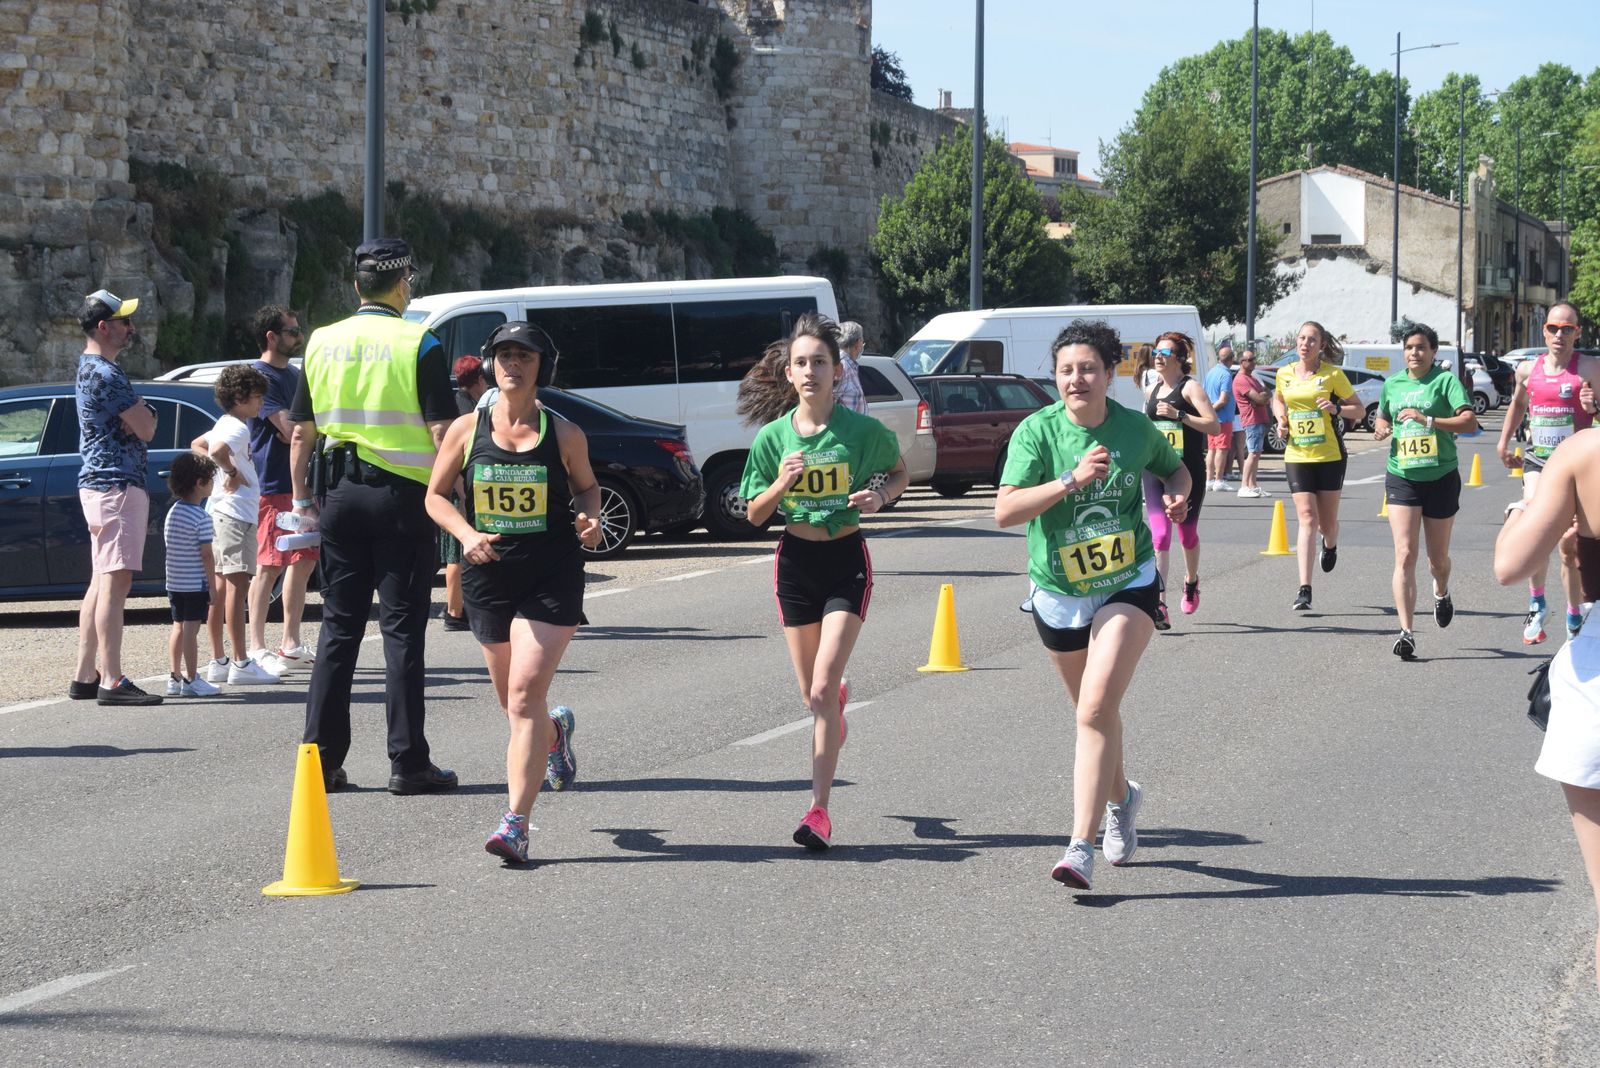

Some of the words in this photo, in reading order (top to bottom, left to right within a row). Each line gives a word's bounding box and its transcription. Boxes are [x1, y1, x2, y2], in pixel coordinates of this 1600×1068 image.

[1297, 420, 1315, 435] 52
[1401, 438, 1430, 456] 145
[788, 467, 838, 493] 201
[482, 485, 536, 513] 153
[800, 500, 818, 508] CAJA
[819, 498, 843, 507] RURAL
[495, 519, 513, 529] CAJA
[515, 519, 542, 529] RURAL
[1078, 532, 1098, 541] CAJA
[1098, 525, 1122, 536] RURAL
[1070, 537, 1125, 575] 154
[1092, 580, 1112, 589] CAJA
[1112, 570, 1136, 585] RURAL
